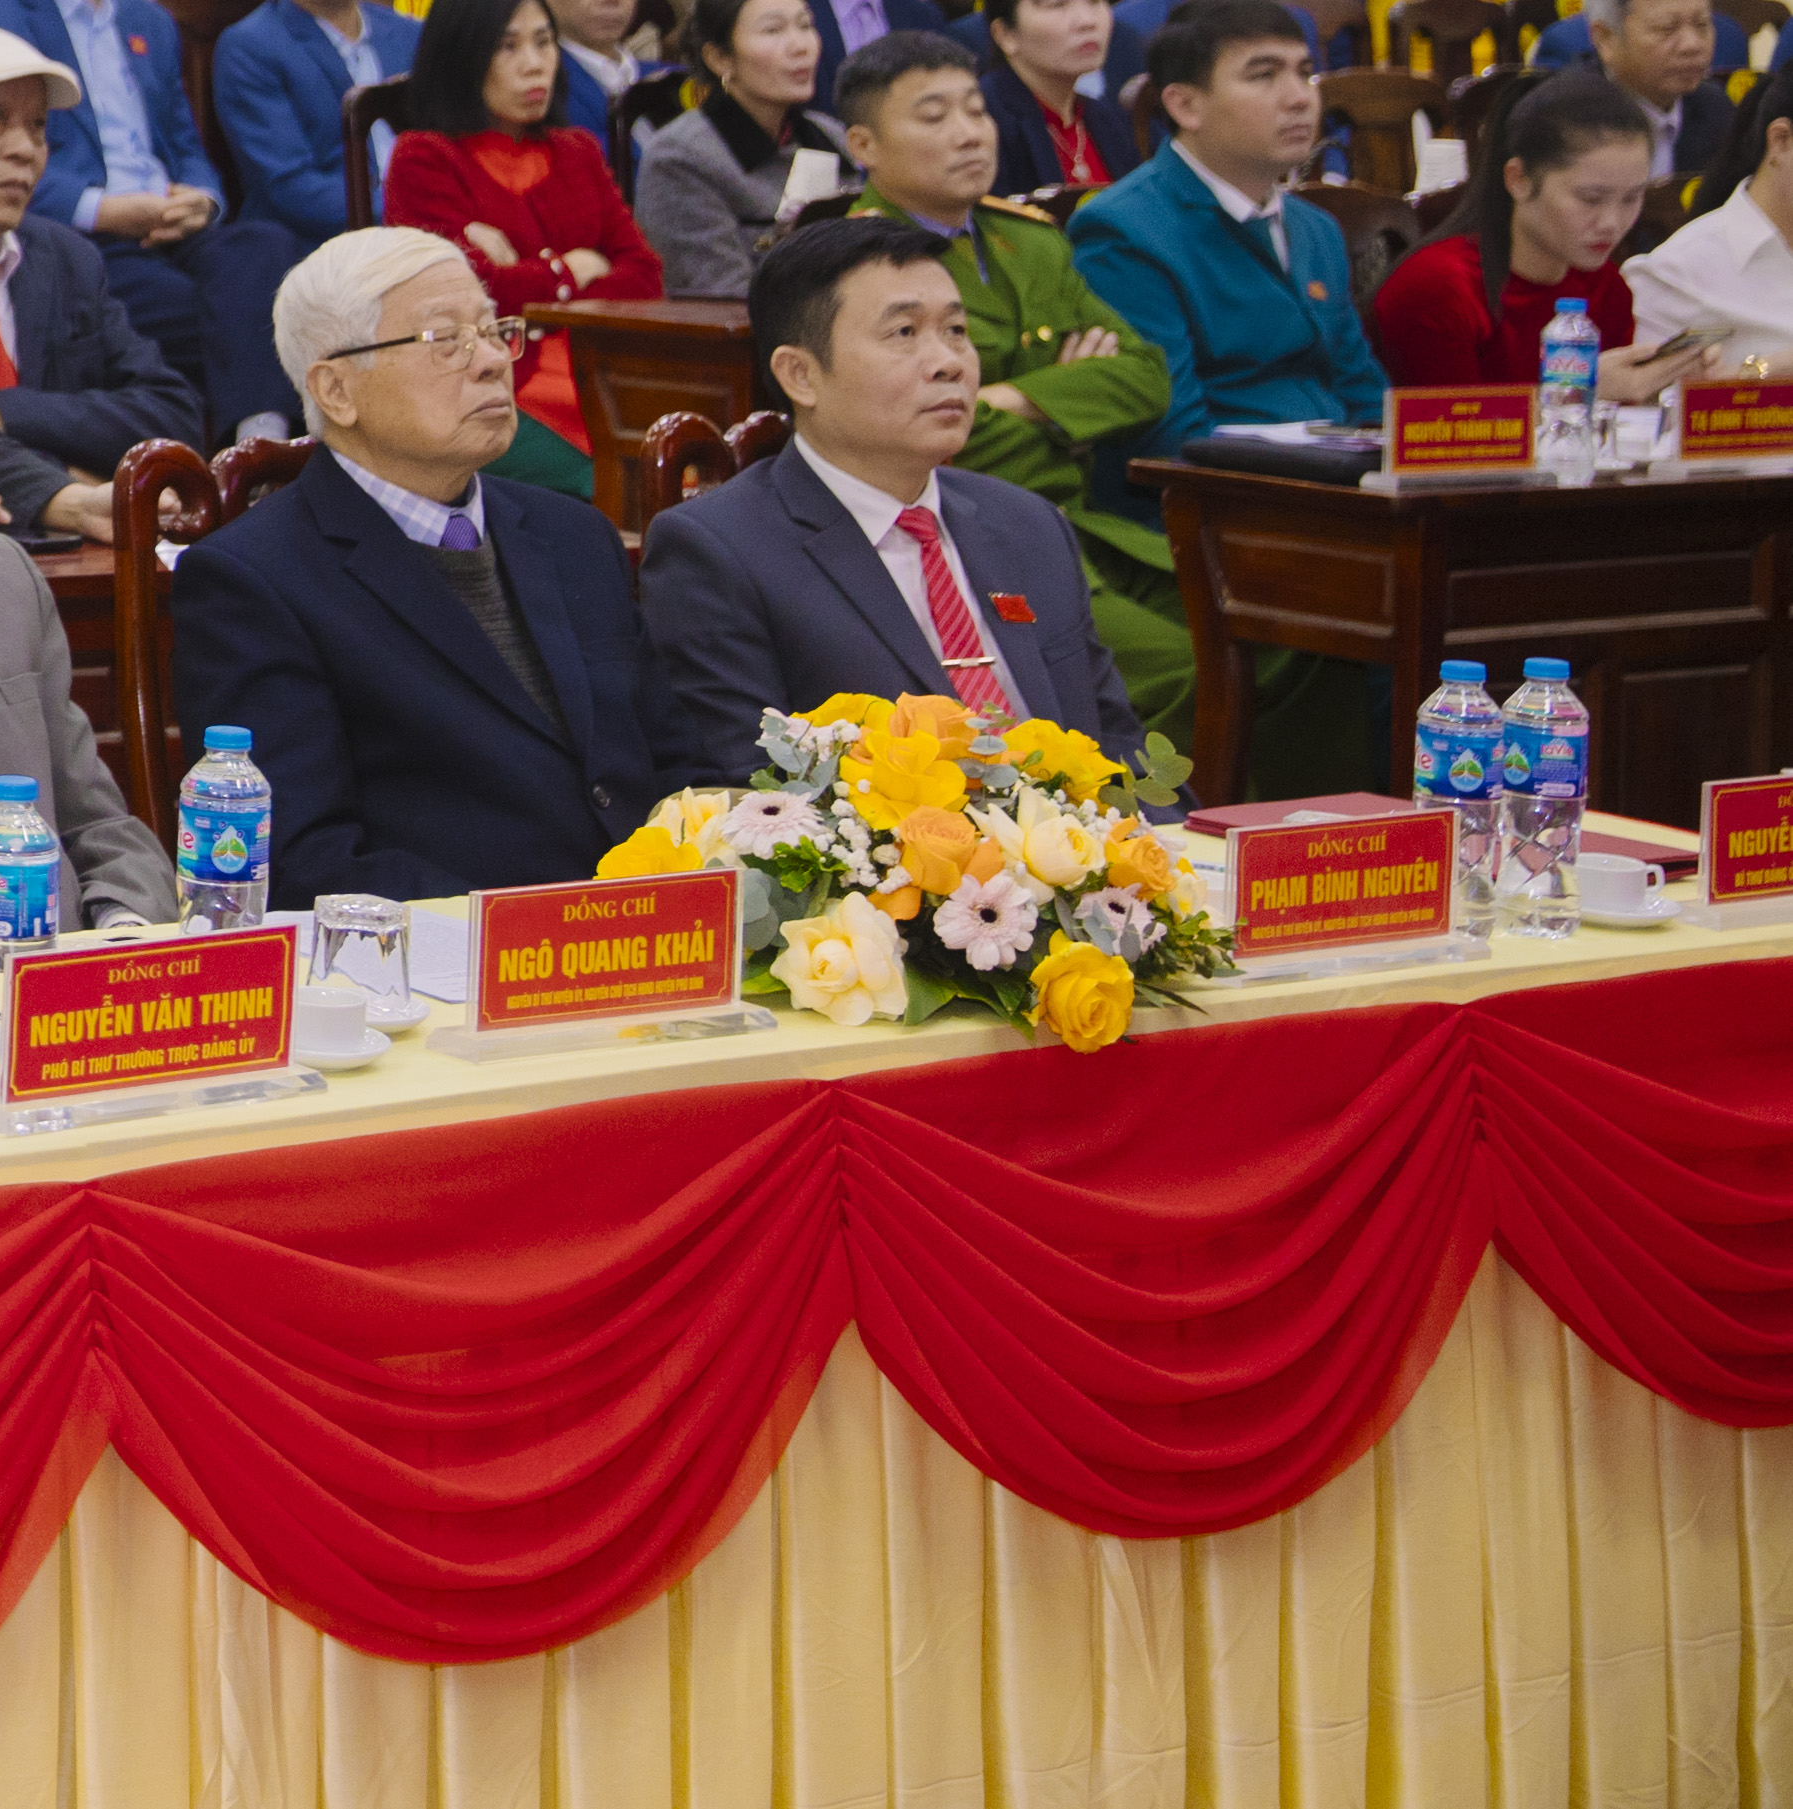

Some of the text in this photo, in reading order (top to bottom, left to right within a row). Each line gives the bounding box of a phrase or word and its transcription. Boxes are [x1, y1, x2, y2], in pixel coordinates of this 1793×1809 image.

[564, 893, 655, 922] ĐỒNG CHÍ
[1251, 857, 1438, 915] PHẠM BÌNH NGUYÊN
[109, 956, 199, 983] ĐỒNG CHÍ
[498, 920, 715, 983] NGÔ QUANG KHẢI
[30, 987, 273, 1047] NGUYỄN VĂN THỊNH
